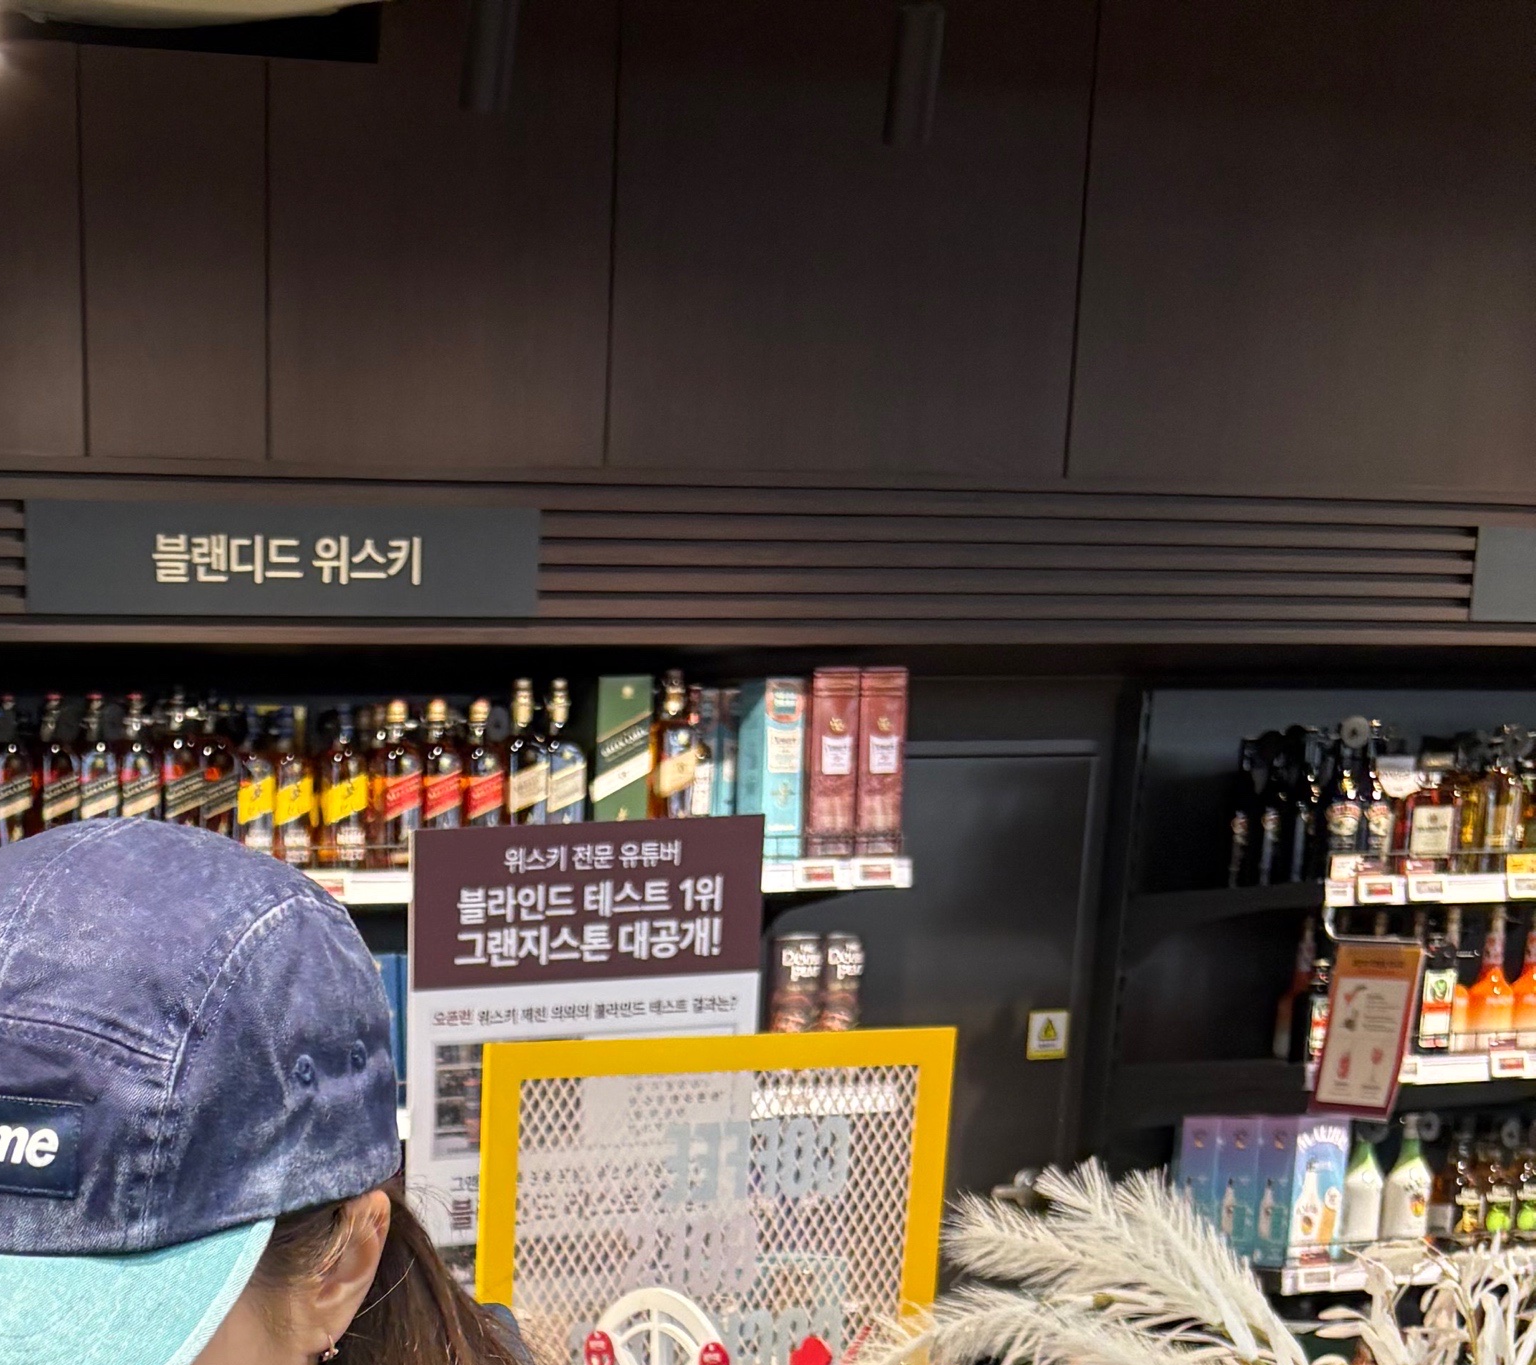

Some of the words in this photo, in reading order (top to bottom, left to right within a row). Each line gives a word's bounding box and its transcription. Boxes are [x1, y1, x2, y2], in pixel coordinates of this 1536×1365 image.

[311, 535, 422, 586] 위스키
[504, 845, 567, 873] 위스키
[572, 843, 614, 870] 전문
[619, 839, 682, 868] 유튜버
[457, 886, 577, 925] 블라인드
[583, 879, 671, 917] 테스트
[678, 873, 724, 912] 1위
[454, 922, 613, 967] 그랜지스톤
[618, 916, 723, 961] 대공개!
